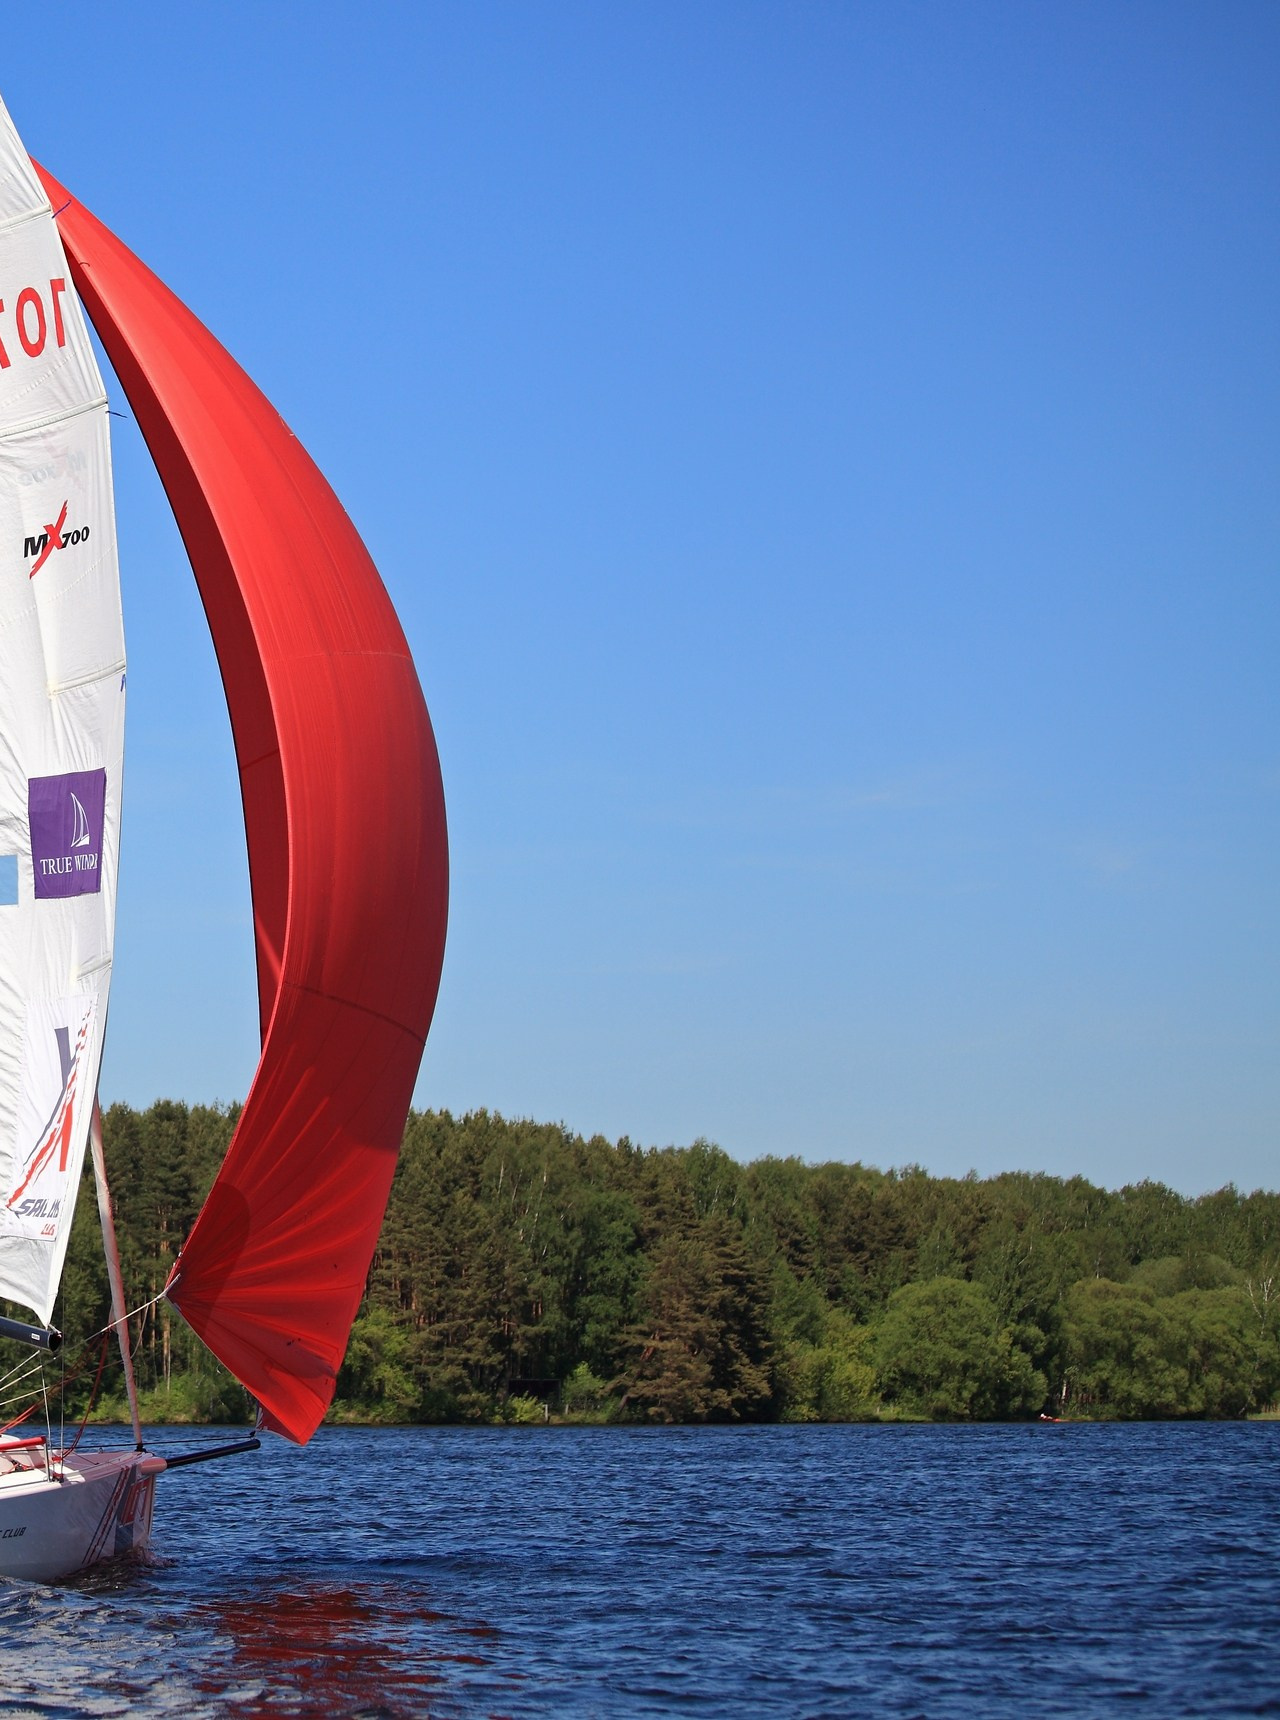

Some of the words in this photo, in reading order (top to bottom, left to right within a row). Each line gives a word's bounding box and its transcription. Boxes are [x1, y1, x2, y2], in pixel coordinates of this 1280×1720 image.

[23, 499, 90, 580] MX700
[40, 856, 73, 875] TRUE
[2, 1526, 28, 1539] CLUB
